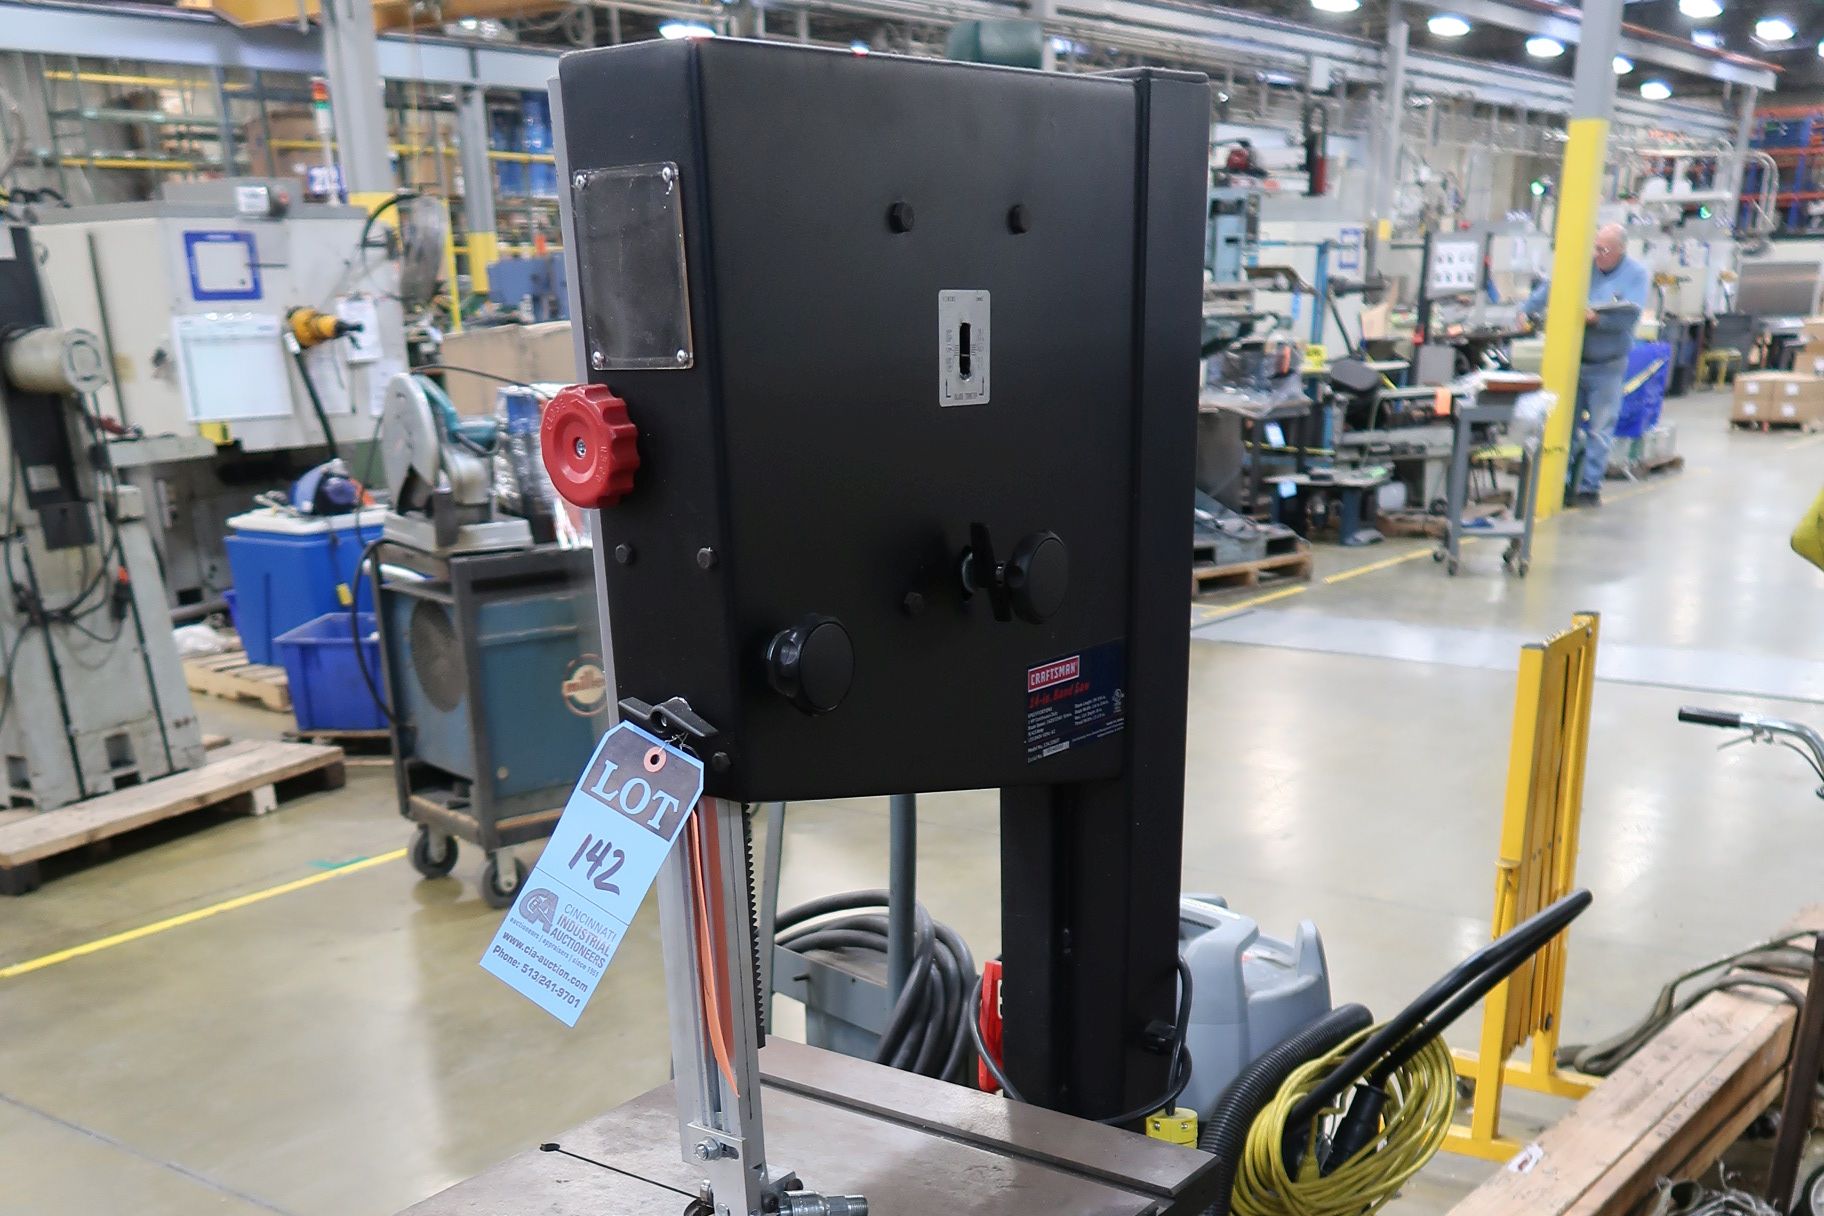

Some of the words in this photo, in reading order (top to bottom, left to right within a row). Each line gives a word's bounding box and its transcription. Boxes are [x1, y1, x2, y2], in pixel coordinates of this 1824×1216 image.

[1030, 662, 1076, 686] CRAFTSMAN
[590, 759, 680, 830] LOT
[568, 833, 625, 896] 142
[510, 917, 540, 939] auctioneers
[542, 938, 569, 959] appraisers
[572, 958, 587, 971] since
[550, 928, 606, 969] AUCTIONEERS
[557, 914, 609, 957] INDUSTRIAL
[564, 903, 617, 942] CINCINNATI
[493, 945, 521, 969] Phone:
[521, 963, 581, 1008] 513/241-9701
[502, 931, 588, 992] www.cia-auction.com
